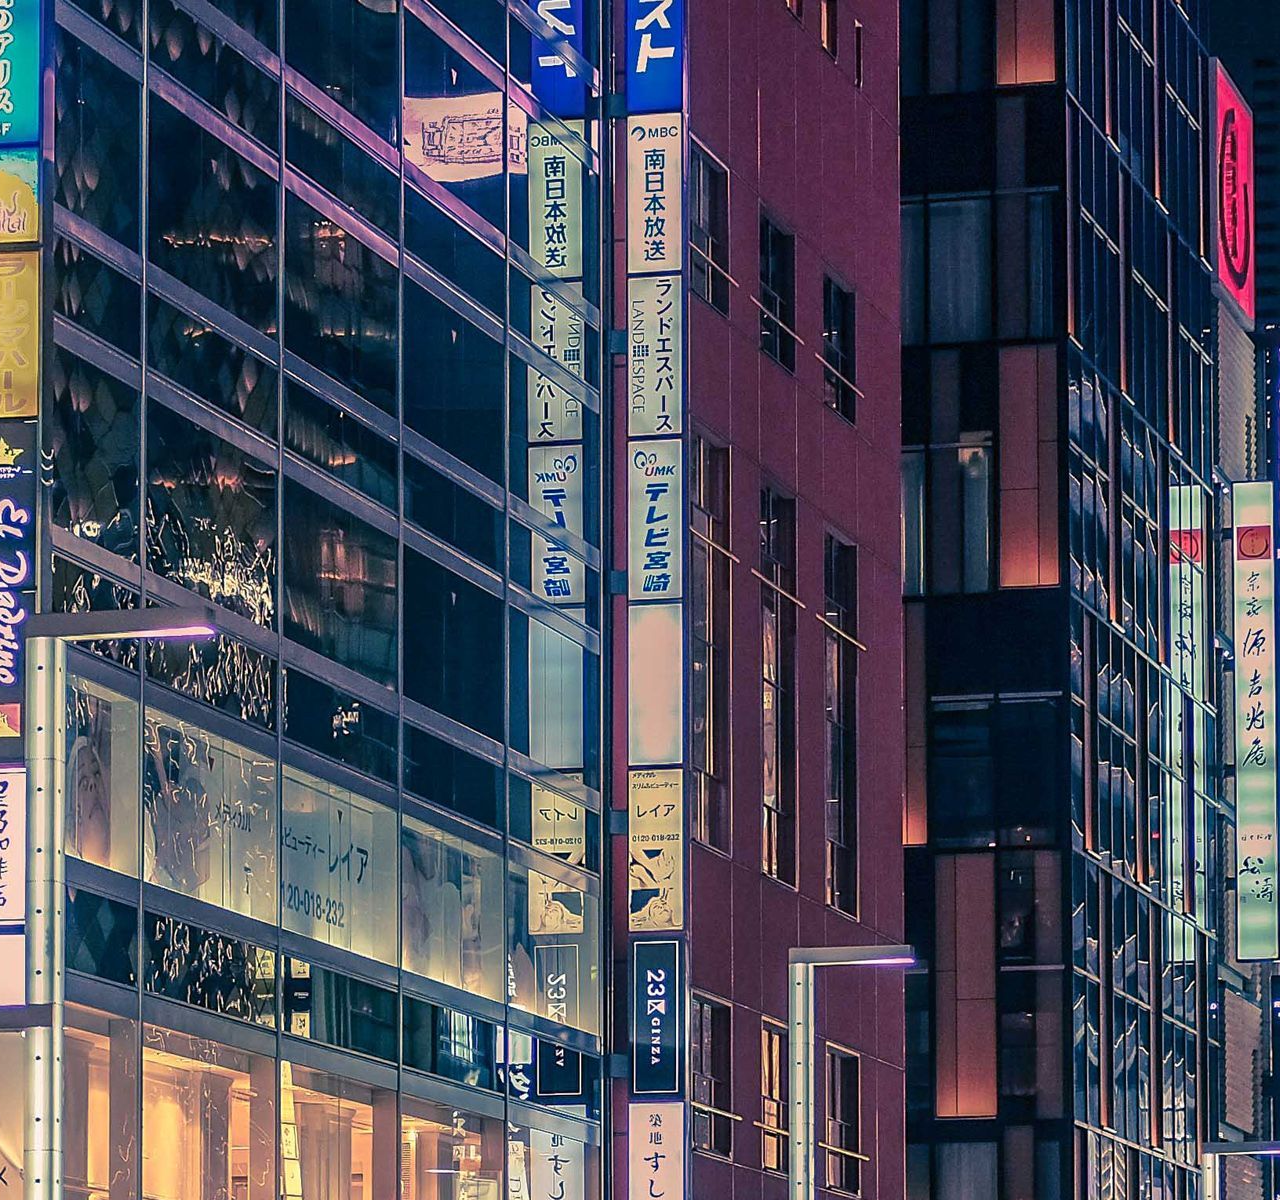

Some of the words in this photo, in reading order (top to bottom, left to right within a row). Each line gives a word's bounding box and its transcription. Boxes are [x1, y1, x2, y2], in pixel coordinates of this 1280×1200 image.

[648, 126, 678, 139] MBC
[644, 149, 666, 261] 南日本放送
[632, 300, 645, 343] LAND
[655, 279, 674, 432] ランドエスパース
[632, 360, 646, 414] ESPACE
[645, 465, 676, 477] UMK
[643, 483, 671, 593] テレビ宮崎
[637, 804, 676, 818] レイア
[651, 1018, 662, 1065] GINZA
